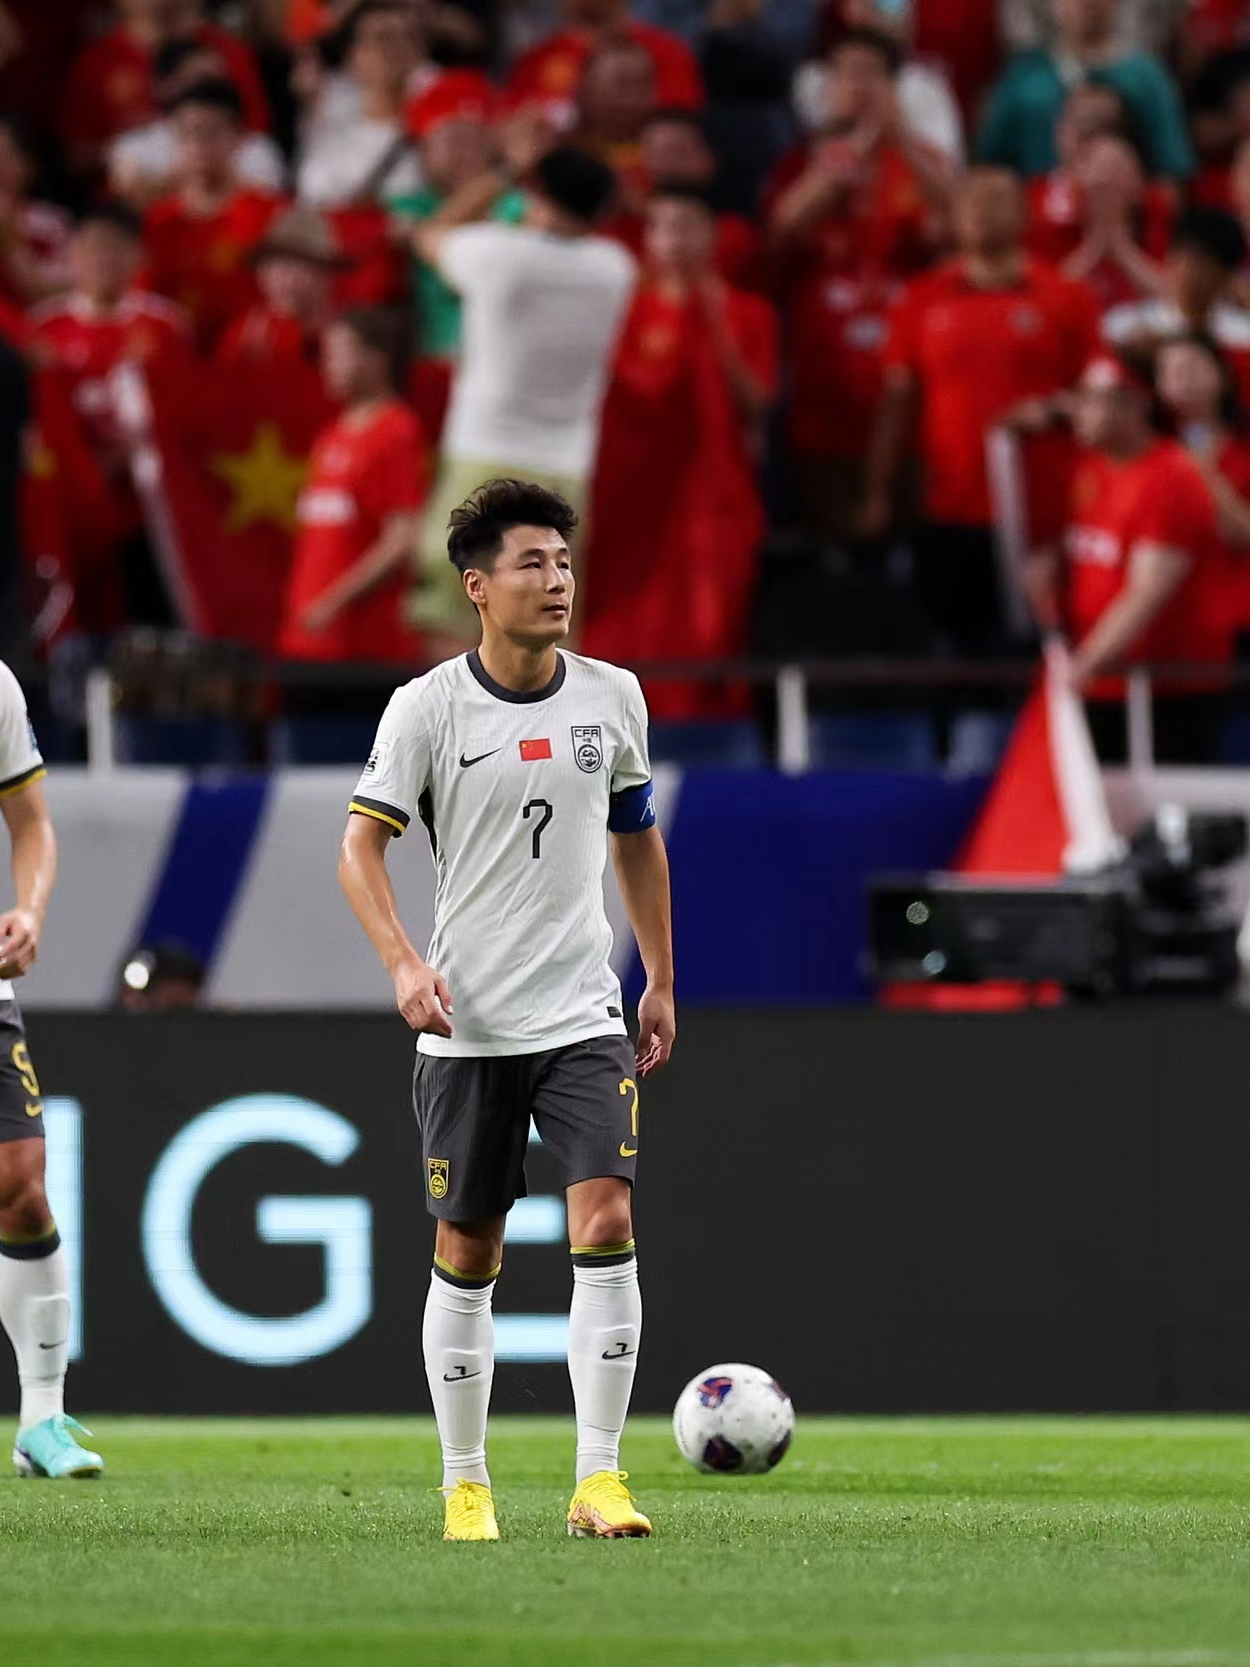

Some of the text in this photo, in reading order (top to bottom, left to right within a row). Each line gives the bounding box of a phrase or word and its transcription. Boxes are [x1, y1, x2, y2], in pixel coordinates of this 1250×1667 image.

[574, 729, 599, 738] CFA
[523, 799, 553, 859] 7
[619, 1078, 638, 1136] 7
